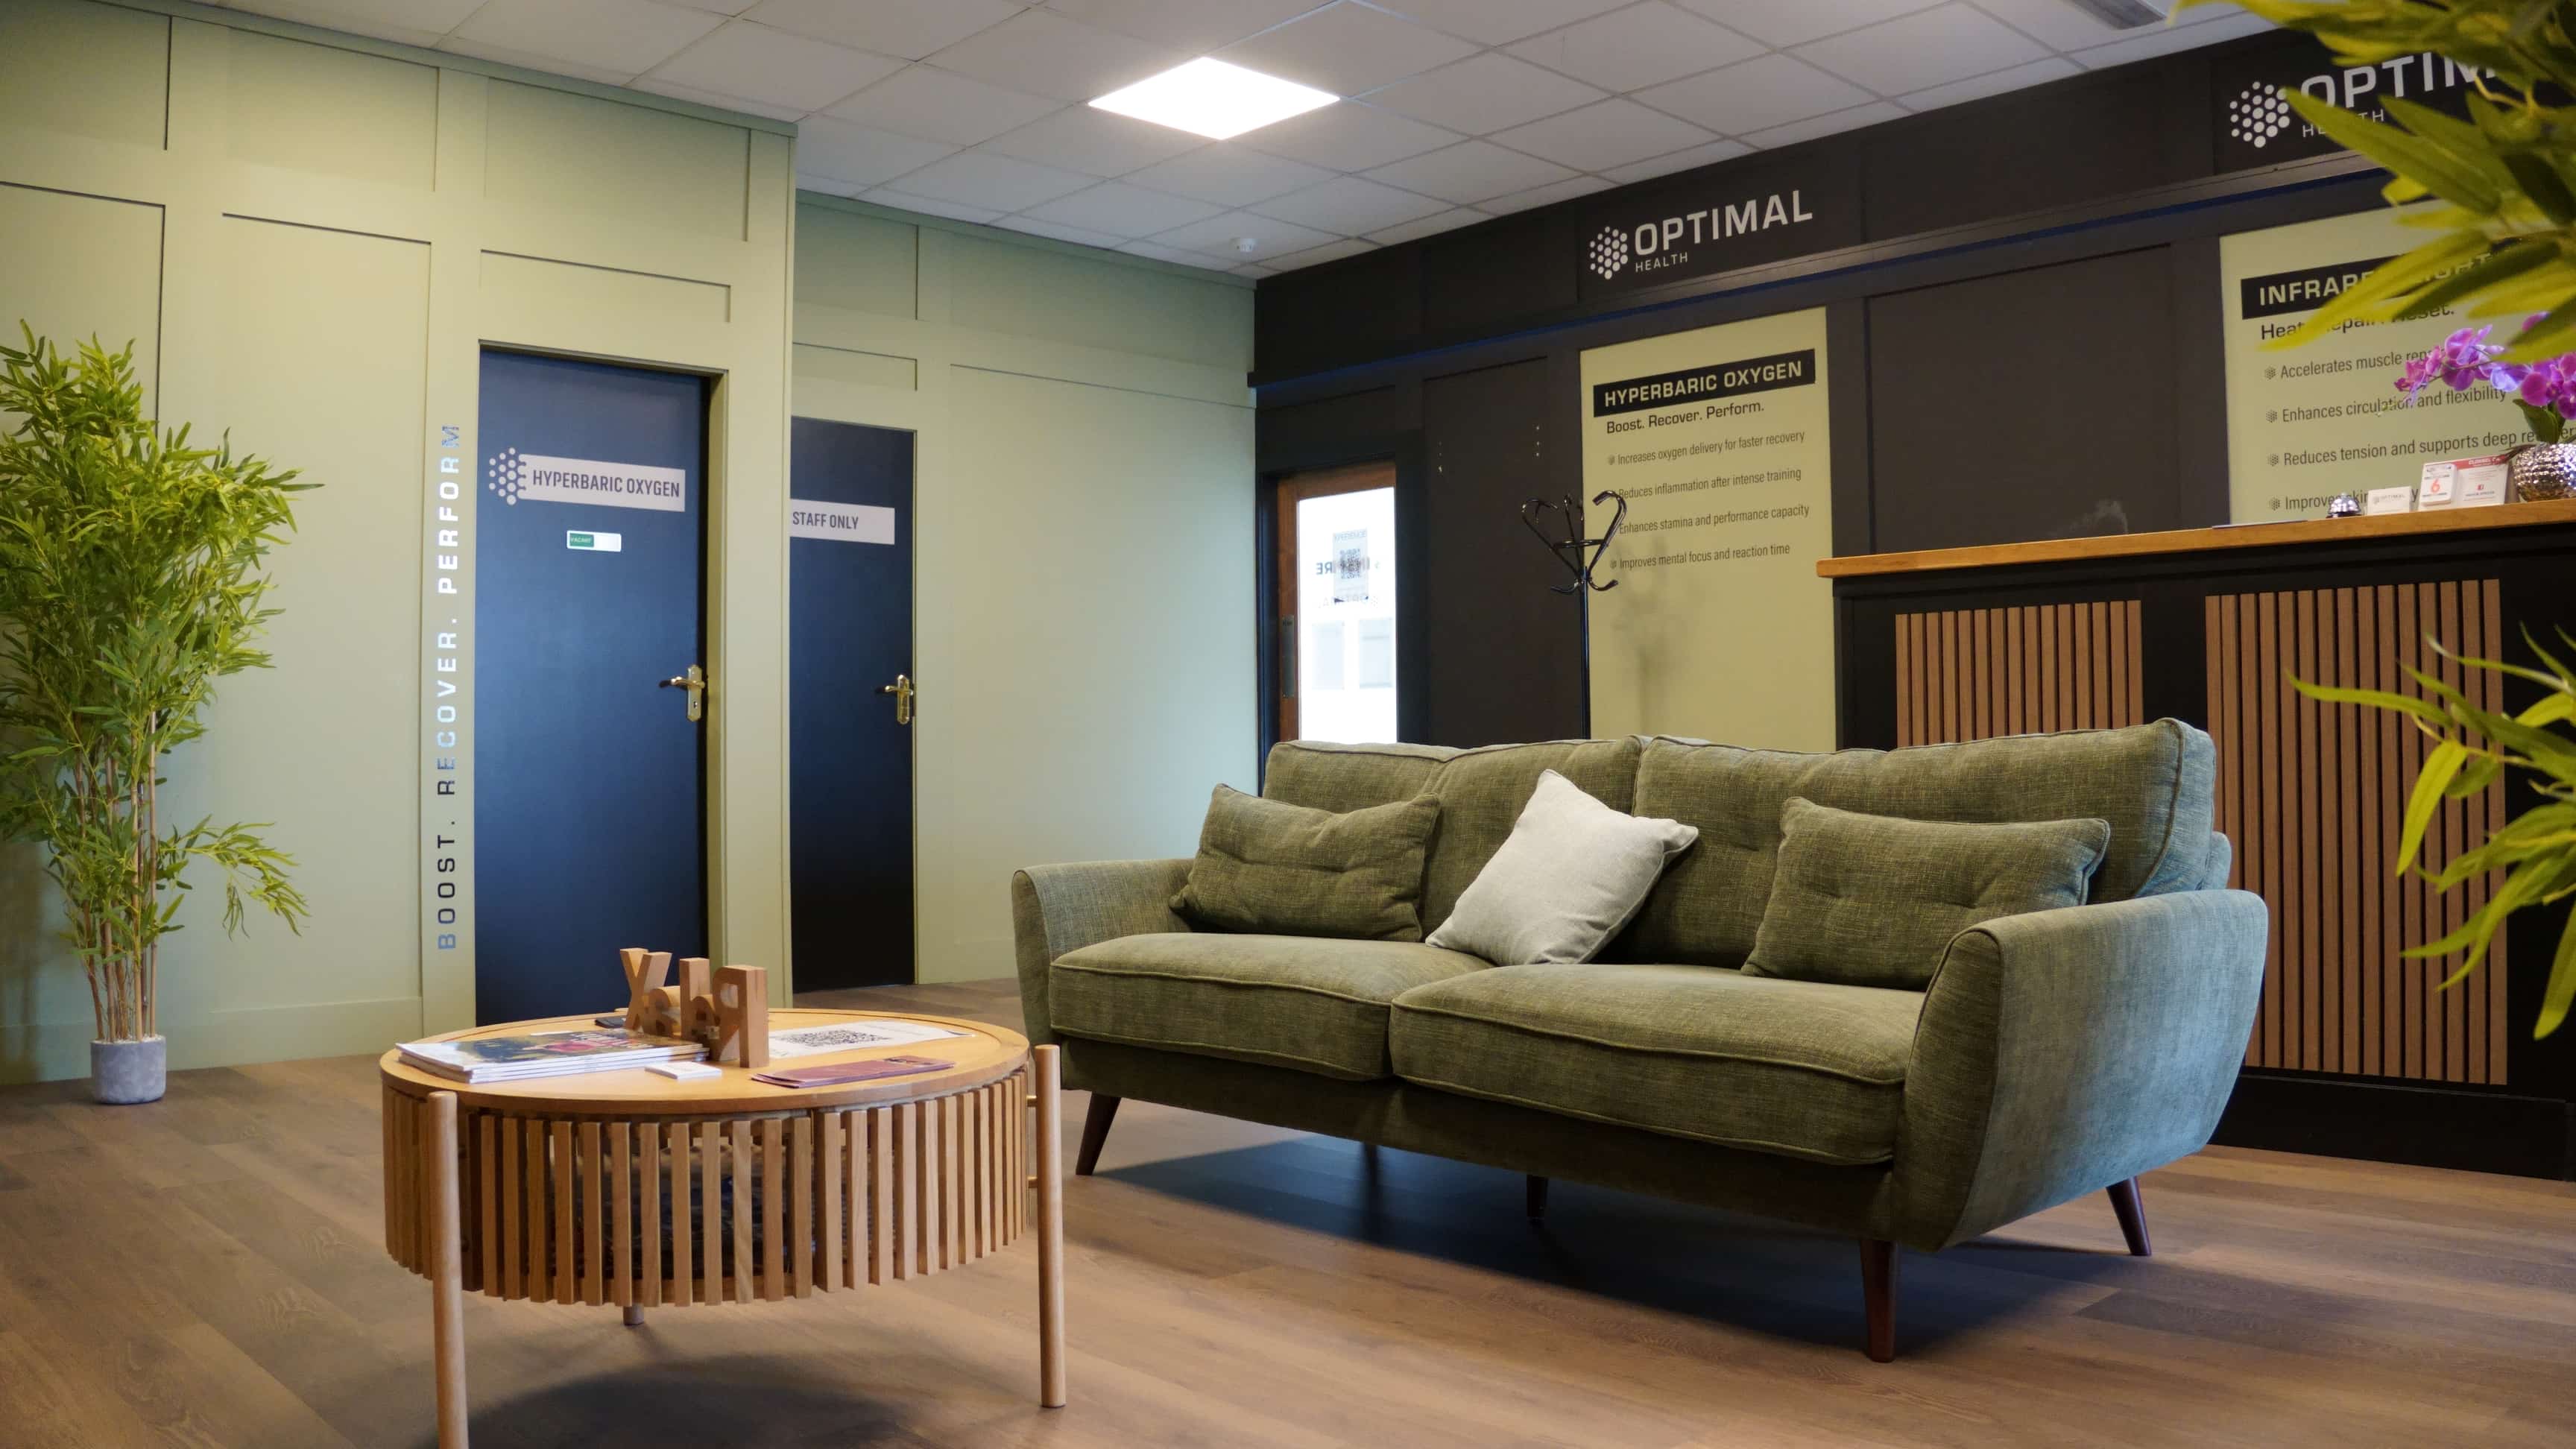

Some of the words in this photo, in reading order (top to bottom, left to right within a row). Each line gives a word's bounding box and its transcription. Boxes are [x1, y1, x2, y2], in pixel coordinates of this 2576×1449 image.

[2300, 51, 2496, 108] OPTIM
[1635, 189, 1813, 256] OPTIMAL
[1635, 252, 1688, 273] HEALTH
[2259, 271, 2375, 306] INFRAR
[2279, 359, 2352, 379] Accelerates
[2355, 350, 2402, 370] muscle
[1604, 374, 1717, 407] HYPERBARIC
[1723, 360, 1802, 388] OXYGEN
[1606, 420, 1645, 434] Boost.
[1648, 411, 1702, 428] Recover.
[1706, 401, 1764, 420] Perform.
[2282, 403, 2343, 423] Enhances
[2416, 391, 2443, 407] and
[2446, 385, 2507, 405] flexibility
[1617, 450, 1656, 466] Increases
[1658, 447, 1688, 461] oxygen
[1690, 443, 1723, 455] delivery
[1724, 438, 1737, 451] for
[1738, 436, 1764, 449] faster
[1765, 431, 1805, 445] recovery
[2284, 449, 2337, 466] Reduces
[2340, 443, 2387, 461] tension
[2390, 439, 2415, 456] and
[2419, 434, 2479, 454] supports
[2483, 432, 2517, 447] deep
[532, 469, 623, 493] HYPERBARIC
[626, 478, 680, 497] OXYGEN
[1618, 486, 1652, 499] Reduces
[1655, 479, 1709, 496] inflammation
[1711, 476, 1730, 489] after
[1732, 473, 1765, 486] intense
[1767, 467, 1802, 482] training
[438, 426, 460, 594] PERFORM
[1619, 521, 1658, 534] Enhances
[1660, 517, 1693, 531] stamina
[1694, 514, 1711, 526] and
[1714, 510, 1769, 528] performance
[1771, 504, 1810, 520] capacity
[2285, 493, 2340, 512] Improve
[792, 511, 827, 527] STAFF
[829, 514, 859, 530] ONLY
[1619, 555, 1657, 571] Improves
[1658, 552, 1688, 566] mental
[1689, 549, 1712, 563] focus
[1714, 547, 1730, 560] and
[1732, 545, 1768, 559] reaction
[1770, 543, 1790, 555] time
[437, 618, 458, 795] RECOVER.
[438, 821, 456, 950] BOOST.
